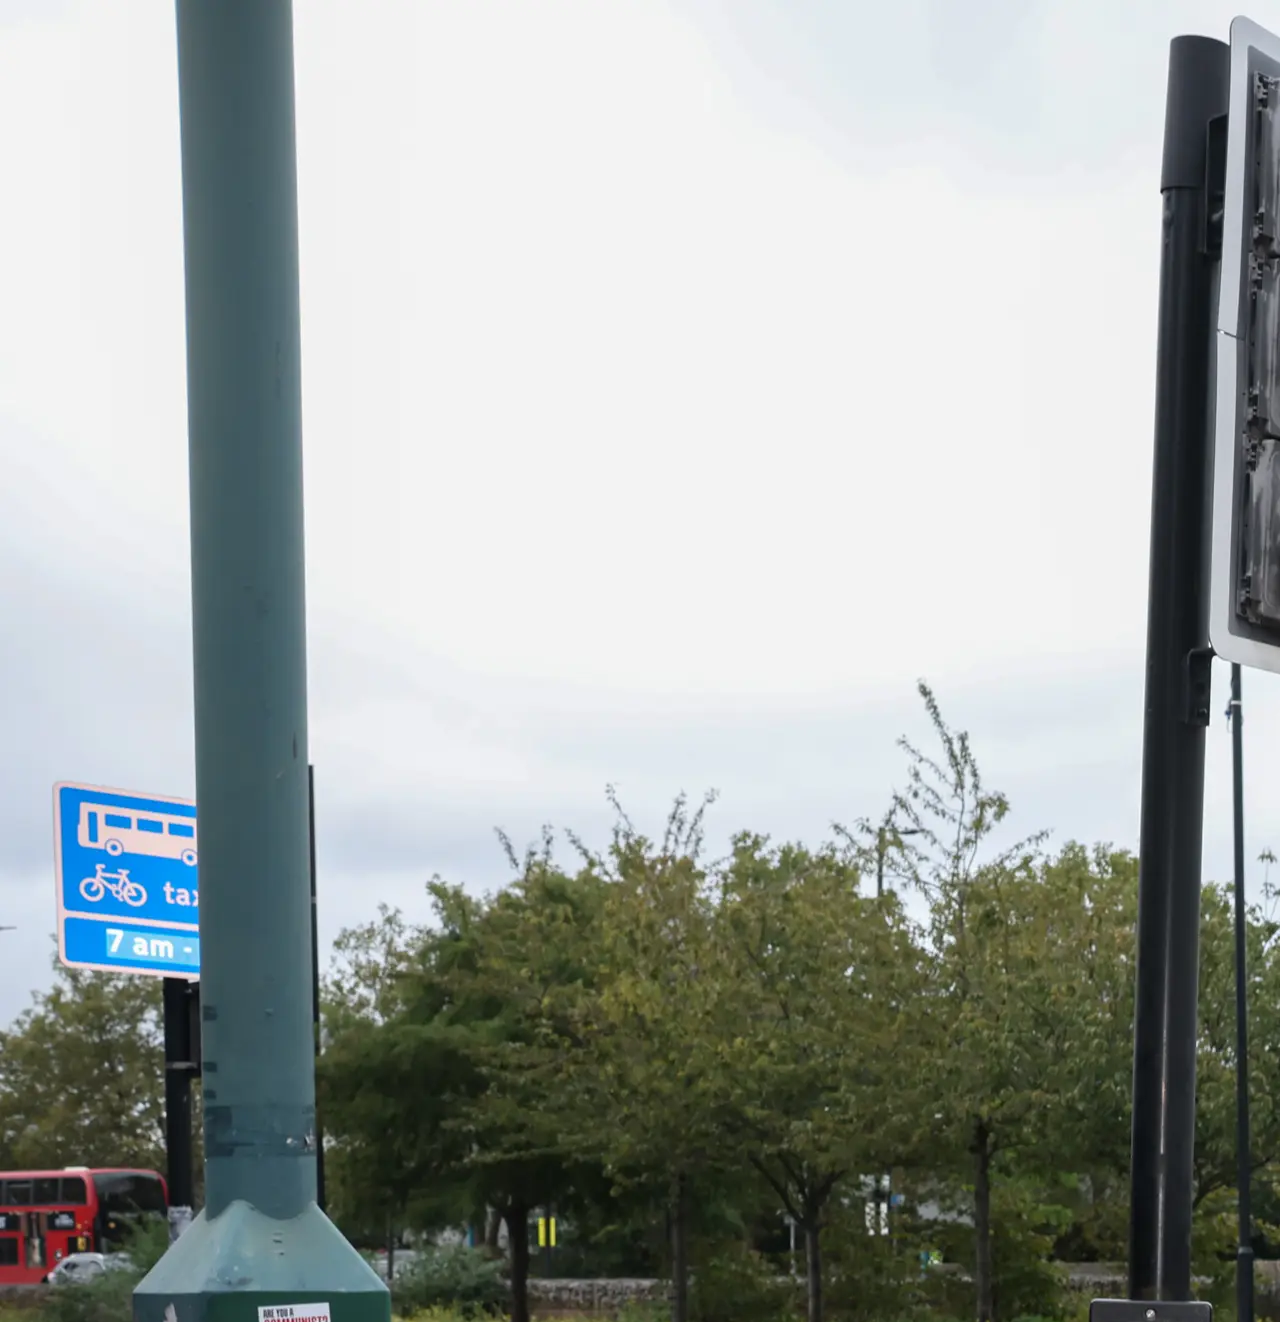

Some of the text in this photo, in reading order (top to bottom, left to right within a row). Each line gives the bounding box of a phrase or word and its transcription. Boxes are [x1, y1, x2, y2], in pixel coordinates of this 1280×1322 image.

[106, 928, 124, 953] 7
[132, 936, 174, 958] am
[263, 1307, 294, 1318] ARE YOU A
